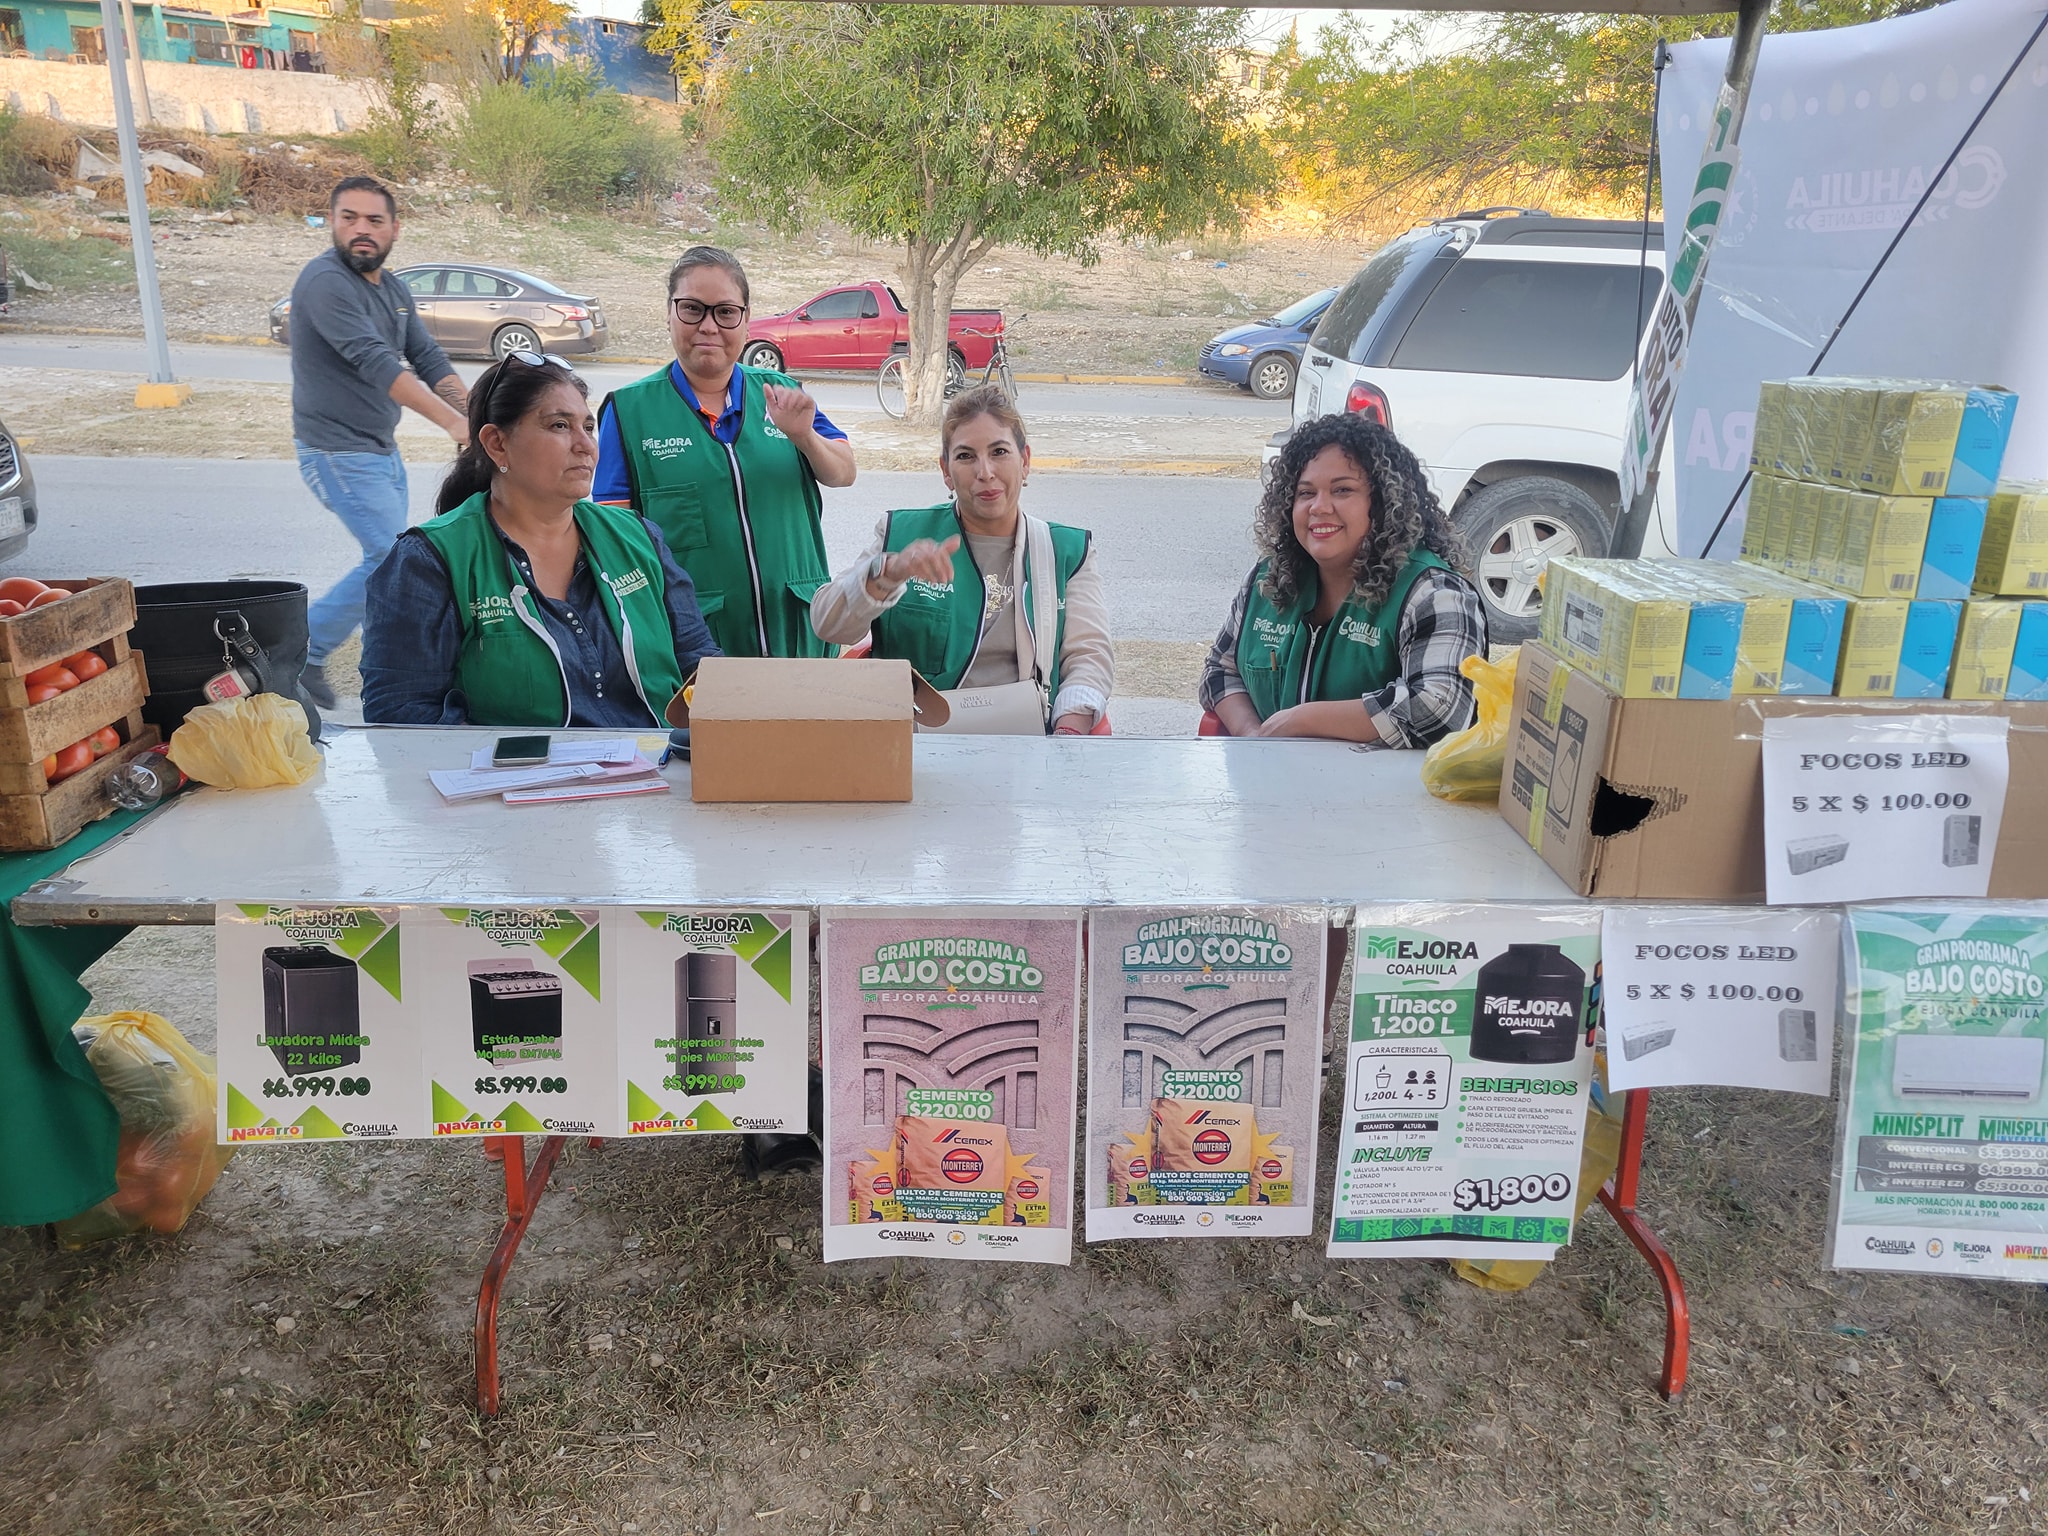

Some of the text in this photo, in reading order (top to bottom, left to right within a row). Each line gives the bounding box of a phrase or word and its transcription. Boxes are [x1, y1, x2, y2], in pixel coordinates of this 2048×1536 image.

[642, 437, 693, 451] MEJORA
[652, 447, 685, 456] COAHUILA
[1800, 752, 1971, 770] FOCOS LED
[1792, 792, 1972, 813] 5 X $ 100.00
[264, 907, 359, 927] MEJORA
[465, 909, 560, 928] MEJORA
[663, 914, 753, 932] MEJORA
[286, 929, 343, 938] COAHUILA
[1139, 916, 1277, 942] GRAN PROGRAMA A
[487, 931, 544, 940] COAHUILA
[684, 934, 738, 943] COAHUILA
[877, 938, 1028, 964] GRAN PROGRAMA A
[1124, 938, 1292, 964] BAJO COSTO
[1367, 935, 1479, 960] MEJORA
[1635, 945, 1798, 961] FOCOS LED
[1917, 940, 2030, 970] GRAN PROGRAMA A
[861, 959, 1044, 986] BAJO COSTO
[1387, 963, 1458, 975] COAHUILA
[1200, 973, 1288, 983] COAHUILA
[1906, 965, 2043, 997] BAJO COSTO
[946, 993, 1039, 1004] COAHUILA
[1627, 983, 1804, 1003] 5 X $ 100.00
[1374, 994, 1457, 1014] Tinaco
[1484, 995, 1573, 1017] MEJORA
[1371, 1016, 1455, 1038] 1,200 L
[1498, 1017, 1555, 1028] COAHUILA
[257, 1034, 371, 1046] Lavadora Midea
[482, 1034, 520, 1045] Estufa
[655, 1038, 726, 1049] Refrigerador
[287, 1053, 304, 1065] 22
[680, 1052, 703, 1064] pies
[663, 1073, 746, 1091] $5,999.00
[1164, 1071, 1242, 1082] CEMENTO
[1164, 1084, 1240, 1100] $220.00
[1460, 1077, 1578, 1096] BENEFICIOS
[909, 1090, 993, 1102] CEMENTO
[1365, 1091, 1398, 1102] 1,200L
[1404, 1089, 1437, 1100] 4 5
[909, 1102, 991, 1120] $220.00
[438, 1120, 502, 1135] Navarro
[542, 1118, 595, 1130] COAHUILA
[632, 1119, 694, 1133] Navarro
[732, 1116, 784, 1128] COAHUILA
[1204, 1118, 1241, 1126] CEMEX
[1873, 1115, 1964, 1137] MINISPLIT
[232, 1126, 300, 1141] Navarro
[342, 1123, 398, 1135] COAHUILA
[953, 1137, 993, 1146] CEMEX
[1193, 1142, 1231, 1152] MONTERREY
[1351, 1147, 1432, 1164] INCLUYE
[1887, 1144, 1968, 1155] CONVENCIONAL
[942, 1161, 983, 1172] MONTERREY
[1889, 1161, 1944, 1171] INVERTER
[1980, 1164, 2048, 1176] $4,999.0
[1891, 1178, 1946, 1188] INVERTER
[942, 1190, 988, 1198] CEMENTO
[1454, 1174, 1570, 1210] $1,800
[1875, 1195, 2046, 1212] MÁS INFORMACIÓN AL 800 000 2624
[927, 1207, 977, 1215] información
[1918, 1208, 1950, 1216] HORARIO
[1133, 1213, 1185, 1224] COAHUILA
[1225, 1214, 1263, 1222] MEJORA
[878, 1229, 935, 1240] COAHUILA
[978, 1233, 1019, 1242] MEJORA
[1865, 1237, 1916, 1250] COAHUILA
[1953, 1241, 1992, 1254] MEJORA
